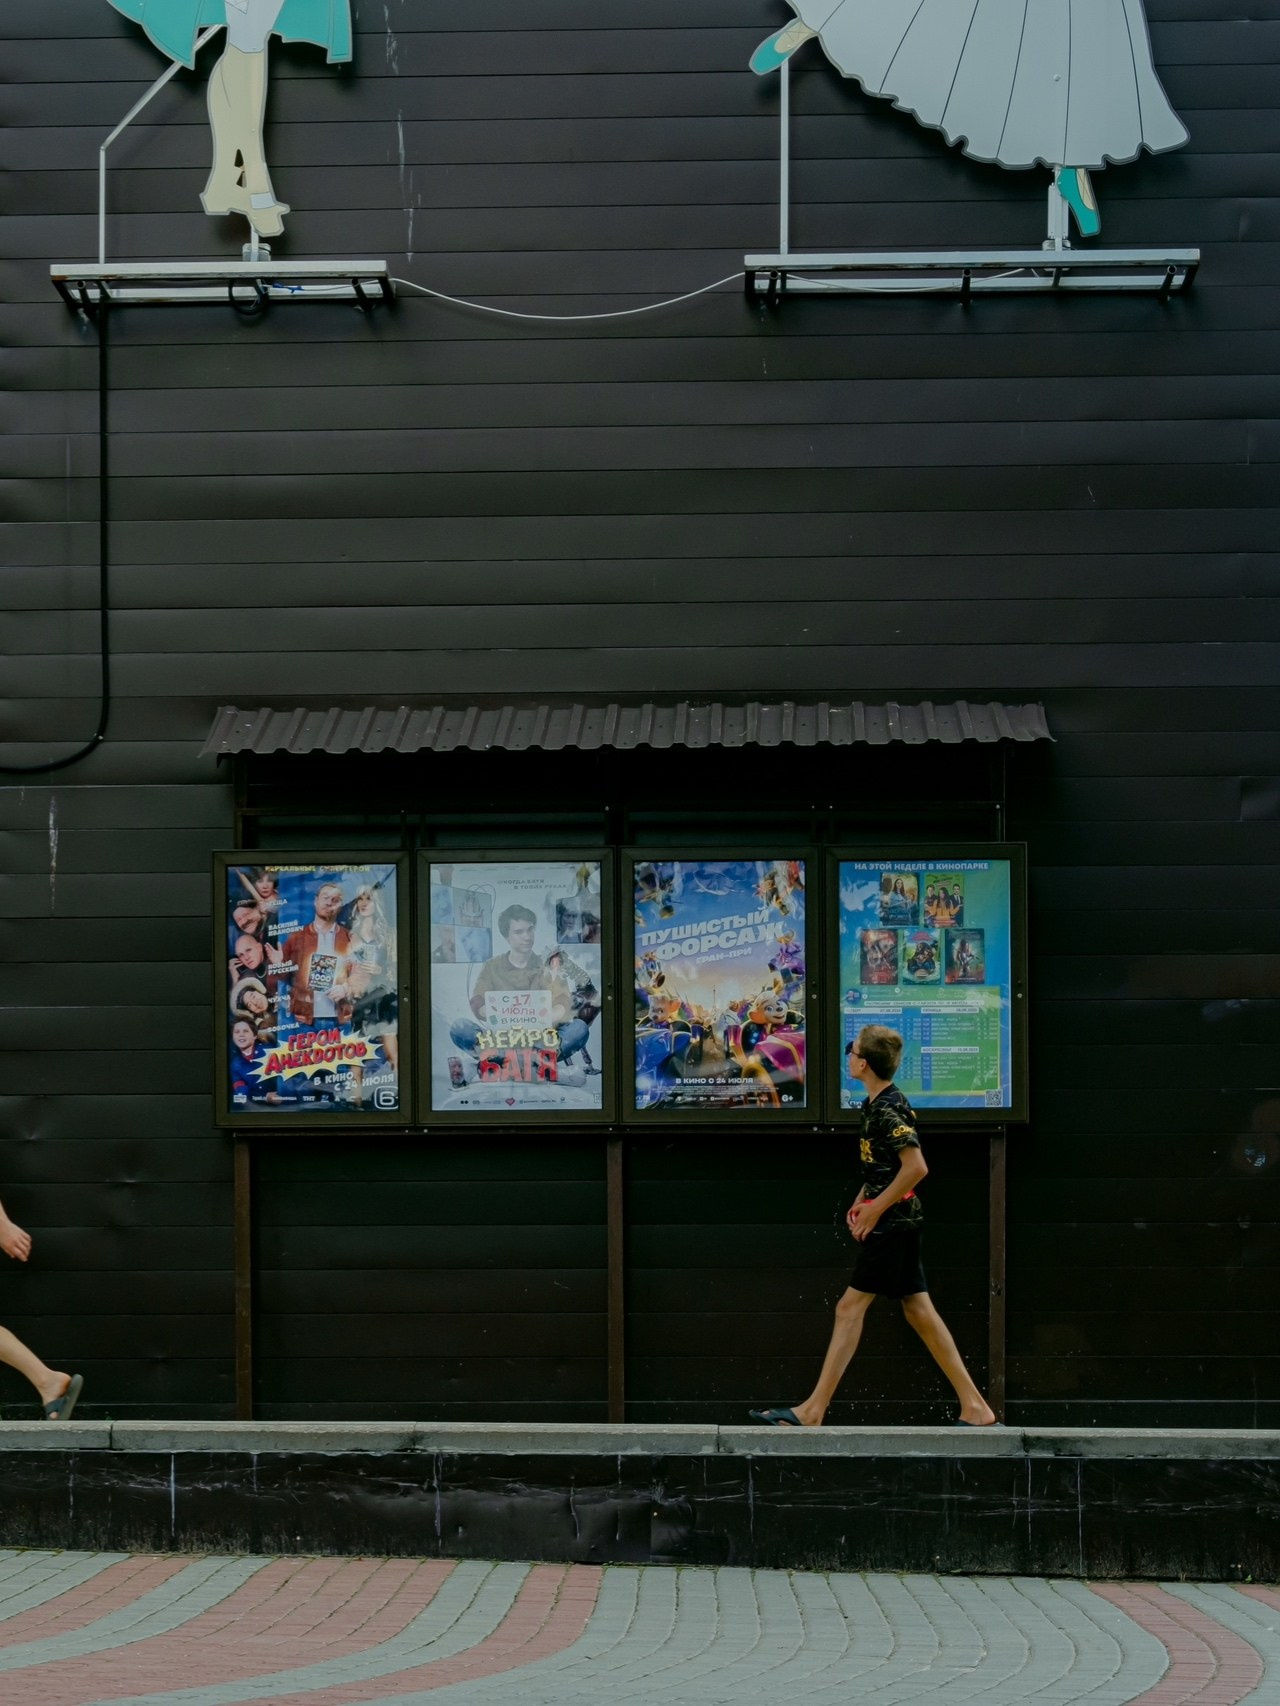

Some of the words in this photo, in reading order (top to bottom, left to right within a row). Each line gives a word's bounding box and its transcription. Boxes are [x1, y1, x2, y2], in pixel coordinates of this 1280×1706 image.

[869, 861, 892, 870] ЭТОЙ
[894, 863, 927, 871] НЕДЕЛЕ
[936, 862, 989, 870] КИНОПАРКЕ
[268, 919, 298, 931] ВАСИЛИЙ
[268, 925, 304, 937] ИВАНОВИЧ
[641, 907, 770, 946] ПУШИСТЫЙ
[655, 921, 785, 961] ФОРСАЖ
[268, 959, 293, 970] НОВЫЙ
[268, 964, 299, 976] РУССКИЙ
[311, 973, 331, 982] 1000
[502, 995, 510, 1003] С
[512, 993, 531, 1006] 17
[502, 1007, 536, 1016] ИЮЛЯ
[510, 1016, 537, 1024] КИНО
[288, 1027, 342, 1051] ГЕРОИ
[476, 1024, 559, 1050] НЕЙРО
[264, 1041, 368, 1076] АНЕКДОТОВ
[478, 1048, 558, 1083] БАТЯ
[313, 1076, 322, 1086] В
[325, 1071, 354, 1084] КИНО
[334, 1082, 341, 1092] С
[344, 1080, 358, 1090] 24
[362, 1073, 394, 1087] ИЮЛЯ
[781, 1094, 794, 1102] 6+
